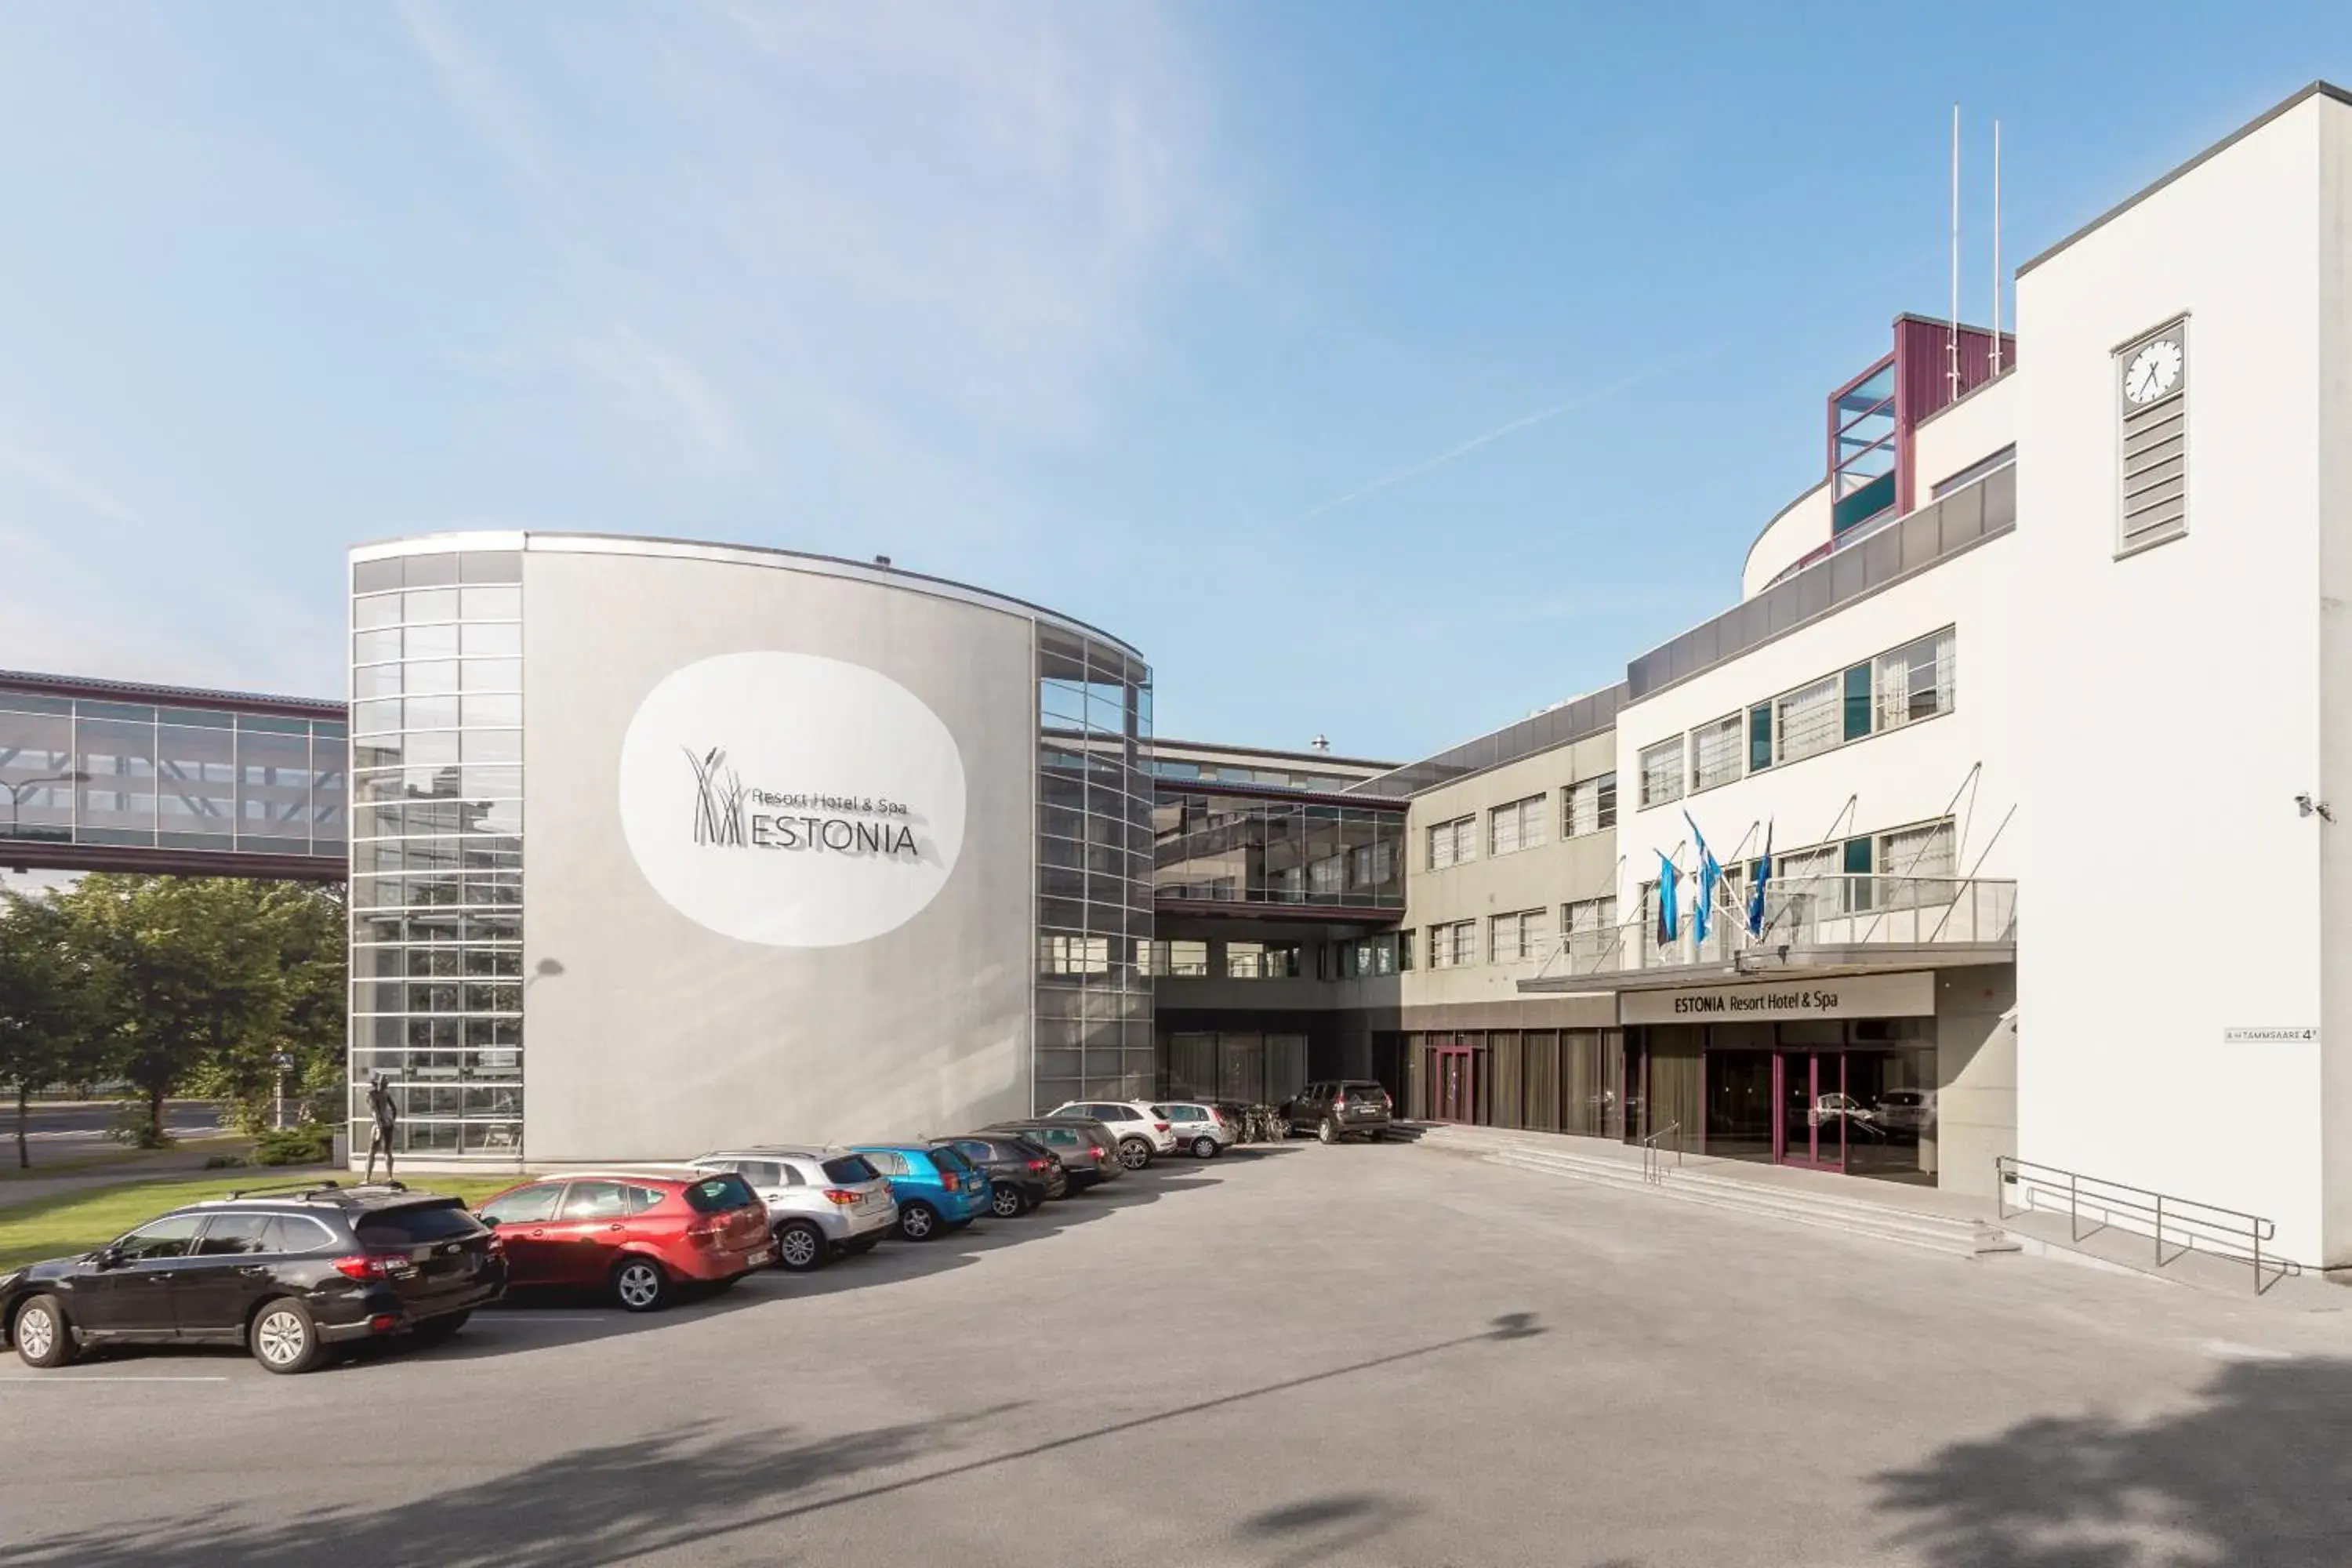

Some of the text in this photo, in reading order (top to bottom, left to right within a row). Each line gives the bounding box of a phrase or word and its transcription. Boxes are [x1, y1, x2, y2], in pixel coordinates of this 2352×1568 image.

[752, 789, 908, 815] Resort Hotel & Spa
[752, 815, 917, 855] ESTONIA
[1675, 990, 1838, 1013] ESTONIA Resort Hotel & Spa
